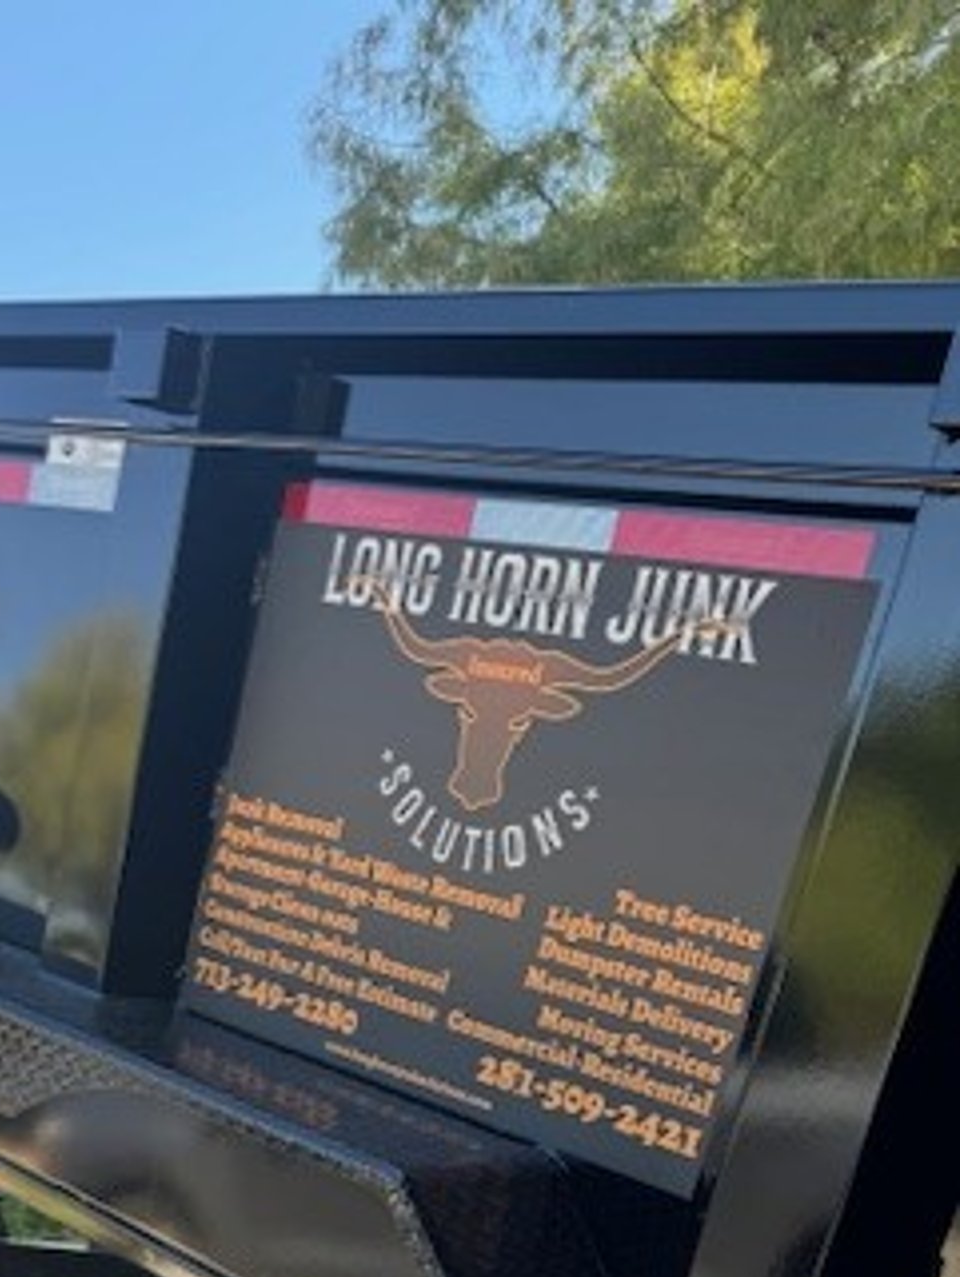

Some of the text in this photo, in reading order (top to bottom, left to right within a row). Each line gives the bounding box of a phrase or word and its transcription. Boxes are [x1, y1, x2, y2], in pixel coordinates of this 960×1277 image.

[323, 534, 778, 664] LONG HORN JUNK
[379, 763, 591, 872] SOLUTIONS
[431, 876, 526, 920] Removal
[616, 889, 765, 951] Tree Service
[539, 938, 744, 1016] Dumpster Rentals
[545, 907, 756, 985] Light Demolitions
[538, 1006, 724, 1086] Moving Services
[632, 1000, 735, 1055] Delivery
[477, 1057, 704, 1159] 281-509-2421
